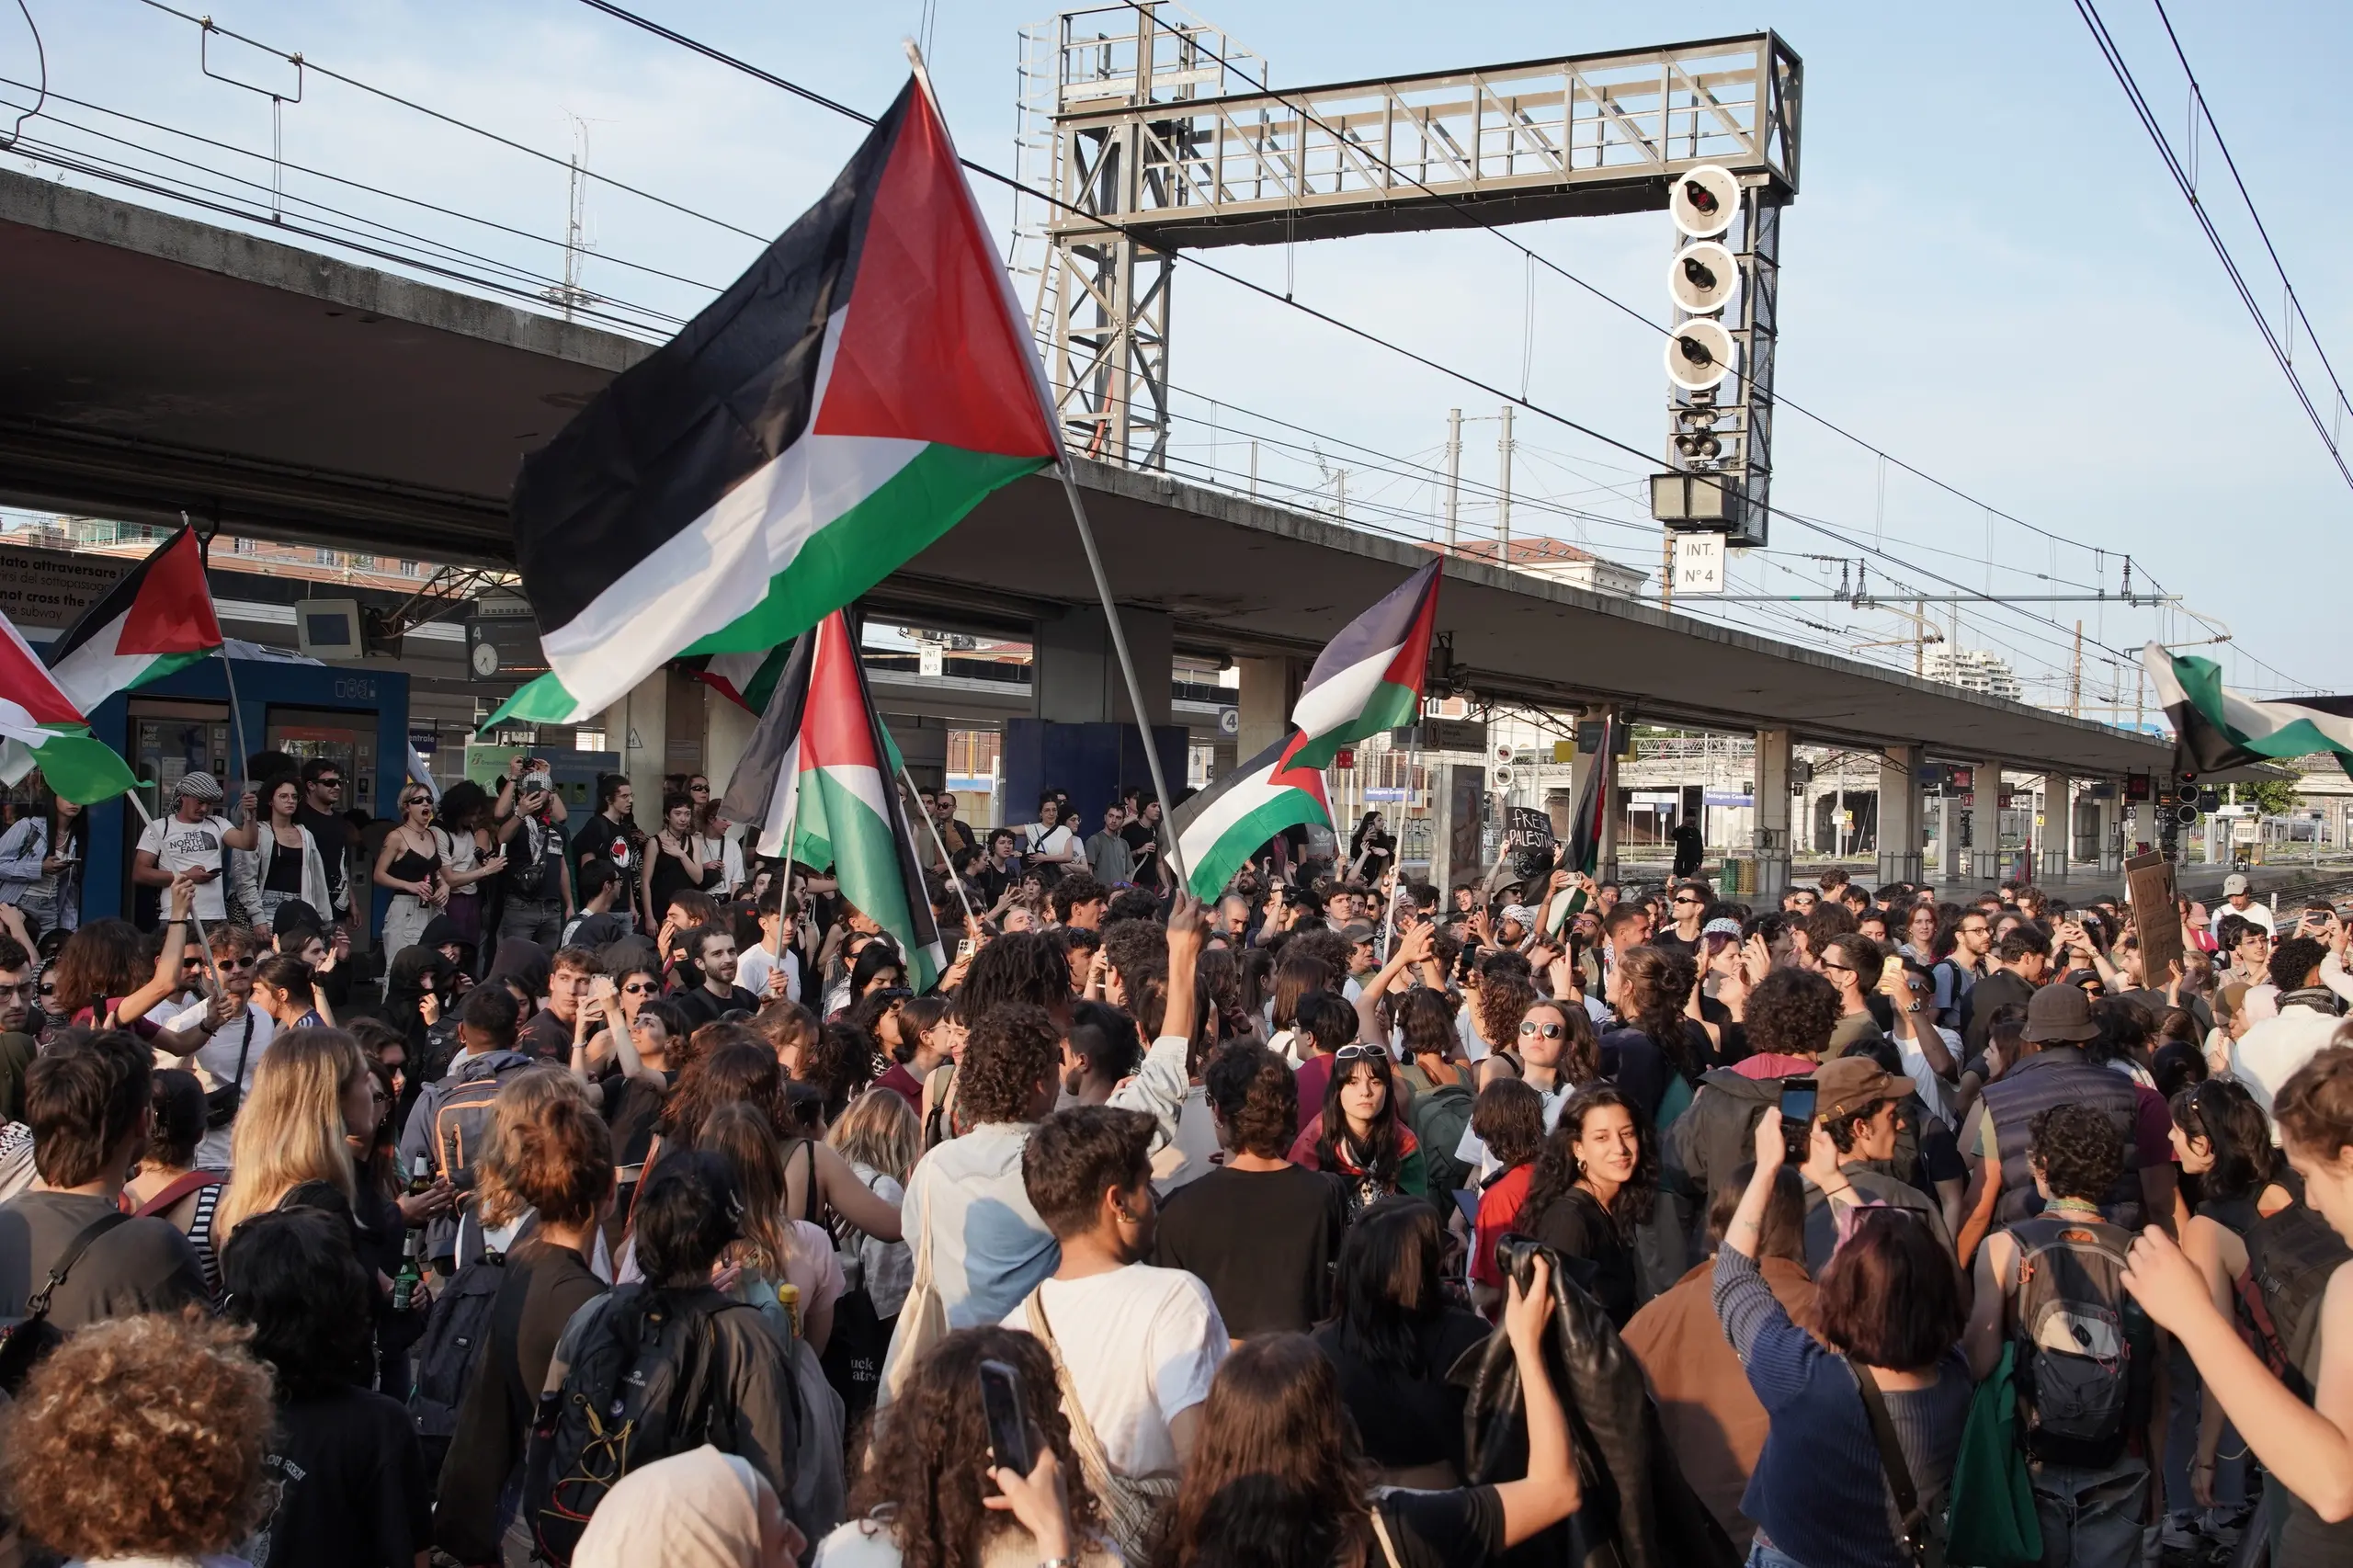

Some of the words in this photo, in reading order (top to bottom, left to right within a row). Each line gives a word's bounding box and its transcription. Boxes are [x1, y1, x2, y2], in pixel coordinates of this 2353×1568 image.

[1687, 543, 1714, 556] INT.
[33, 560, 117, 579] attraversare
[20, 572, 37, 584] del
[1704, 570, 1713, 582] 4
[27, 593, 60, 605] cross
[63, 594, 85, 607] the
[20, 608, 63, 620] subway
[473, 627, 483, 640] 4
[1226, 714, 1236, 728] 4
[1795, 784, 1802, 795] T
[170, 838, 203, 849] NORTH
[181, 845, 205, 854] FACE
